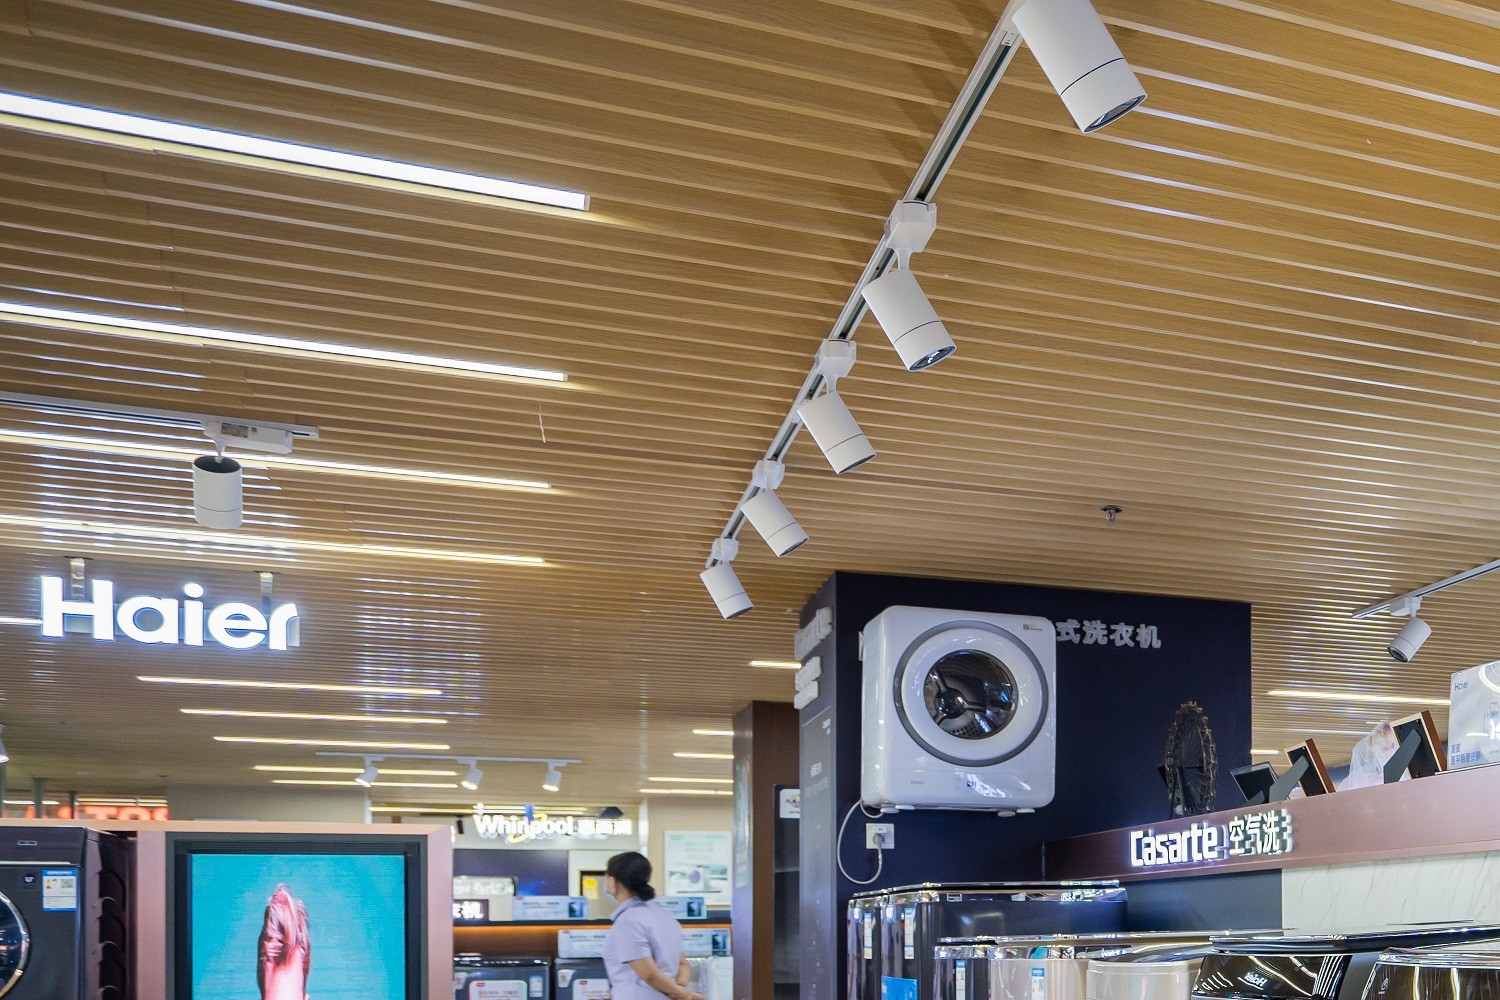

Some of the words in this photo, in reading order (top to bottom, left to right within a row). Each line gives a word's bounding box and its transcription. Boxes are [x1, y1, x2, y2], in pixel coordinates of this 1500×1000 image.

[41, 576, 299, 650] Haier
[1056, 618, 1163, 650] 式洗衣机
[473, 814, 574, 838] Whirlpool
[1130, 823, 1219, 867] Casarte
[1229, 809, 1292, 856] 空气洗
